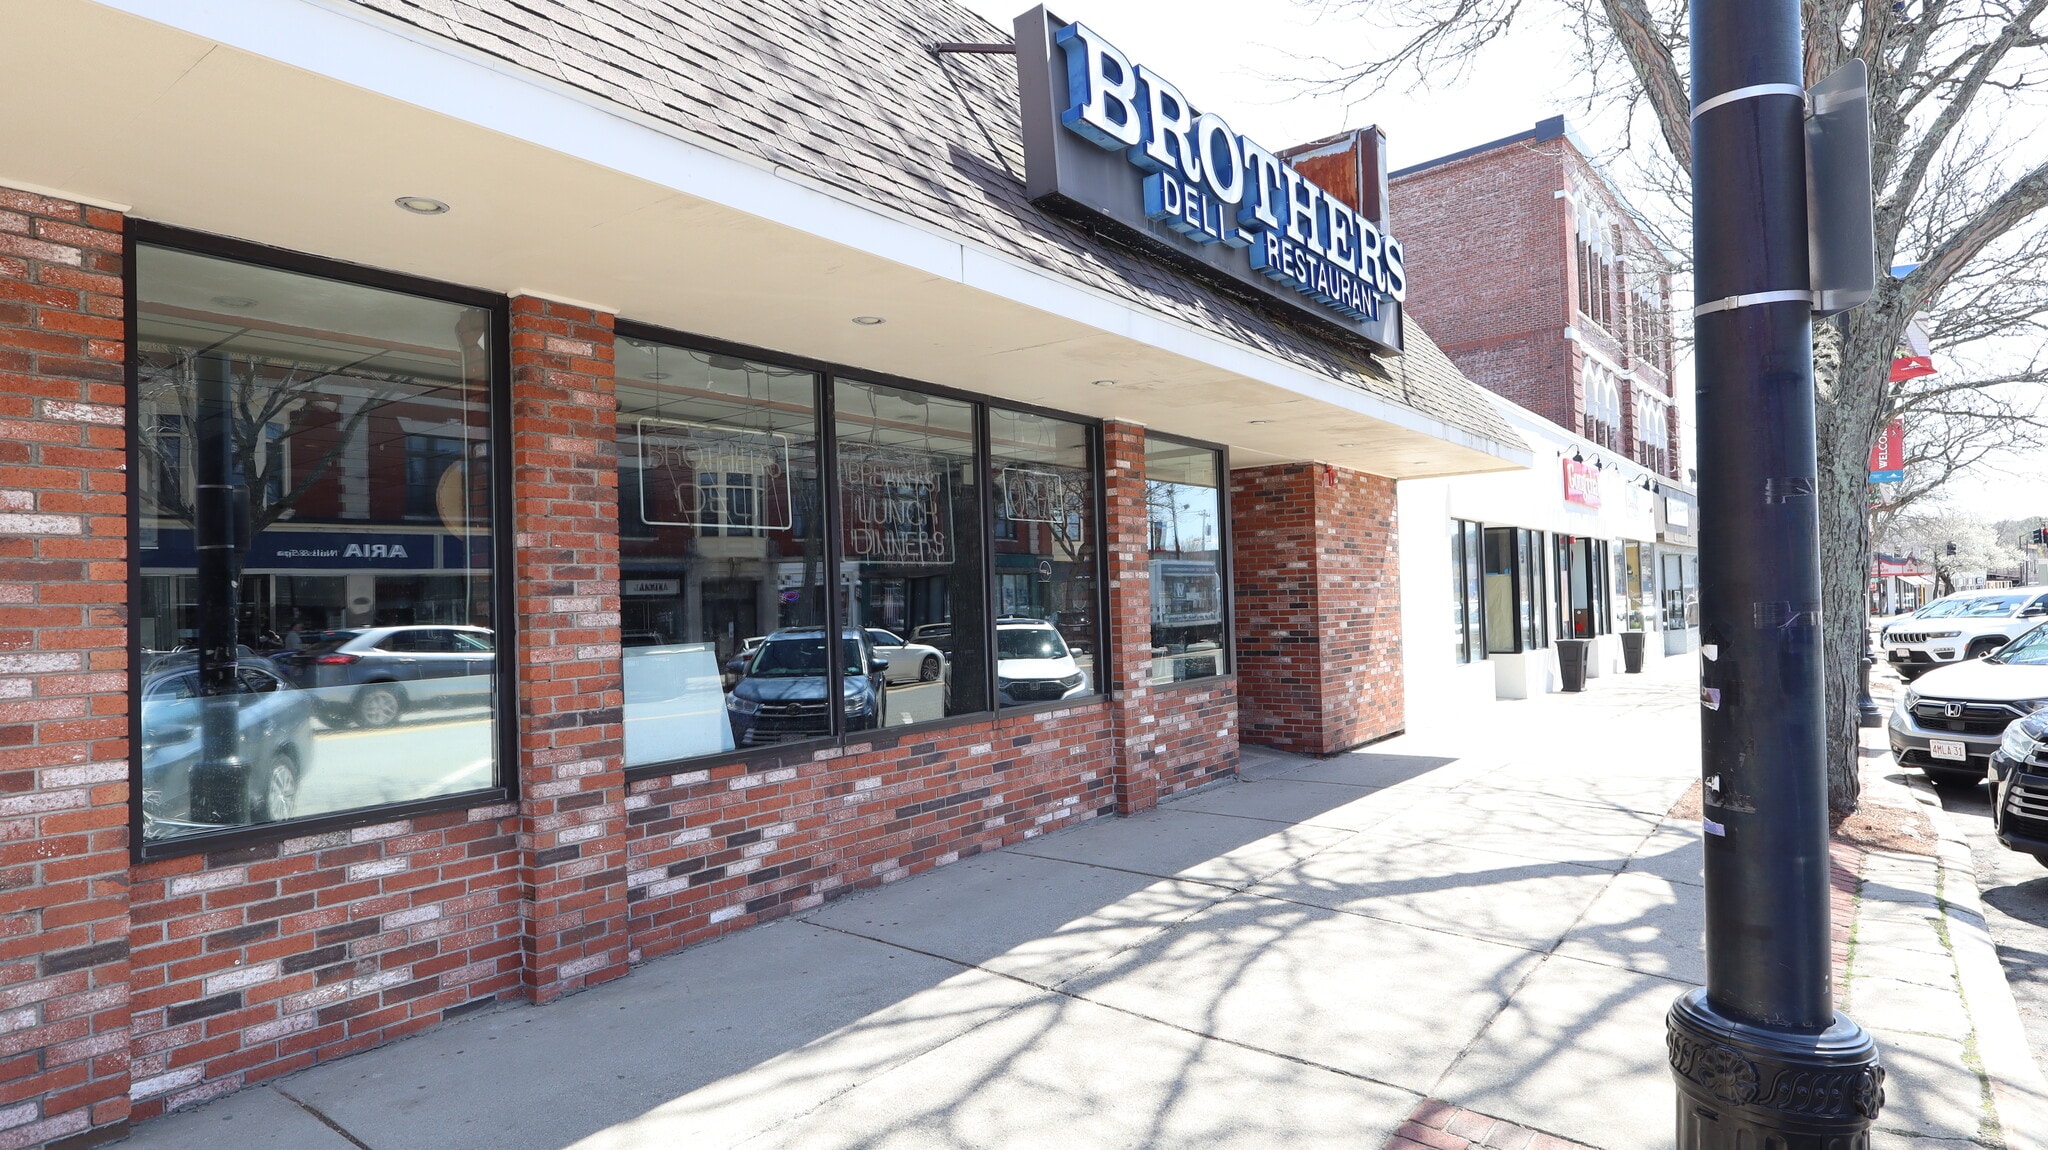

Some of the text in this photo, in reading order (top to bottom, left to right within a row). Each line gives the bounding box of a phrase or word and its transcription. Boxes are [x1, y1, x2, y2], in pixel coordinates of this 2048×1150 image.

[1072, 20, 1407, 303] BROTHERS
[1162, 172, 1225, 242] DELI
[1267, 235, 1382, 321] RESTAURANT
[647, 435, 782, 478] BROTHERS
[1878, 427, 1888, 469] WELCO
[677, 483, 758, 517] DELI
[857, 495, 938, 526] LUNCH
[853, 528, 945, 556] DINNERS
